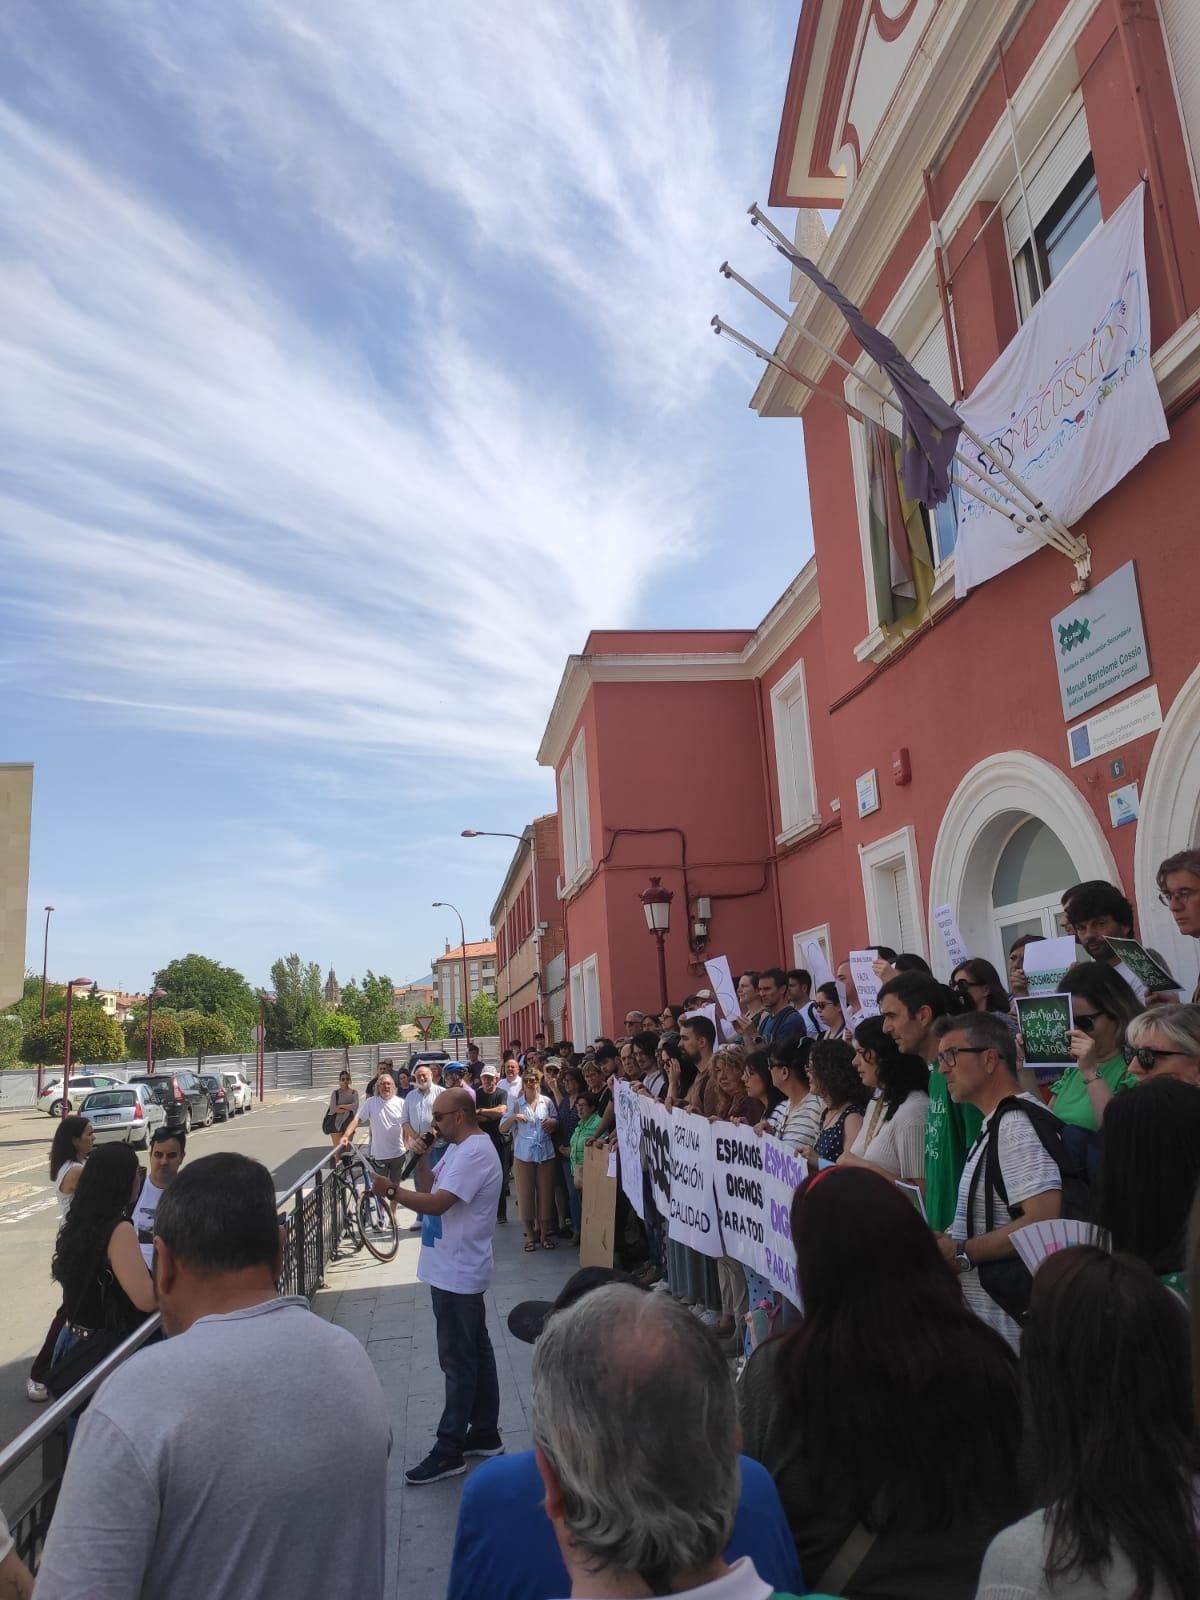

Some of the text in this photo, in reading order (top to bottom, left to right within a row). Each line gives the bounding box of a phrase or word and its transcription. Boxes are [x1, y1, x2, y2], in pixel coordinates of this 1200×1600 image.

[1066, 677, 1086, 697] Manuel
[1087, 657, 1118, 685] Bartolomé
[1114, 762, 1120, 775] 6
[686, 1129, 700, 1152] UNA
[716, 1138, 764, 1171] ESPACIOS
[726, 1173, 764, 1210] DIGNOS
[670, 1198, 710, 1234] CALIDAD
[765, 1247, 793, 1291] PARA
